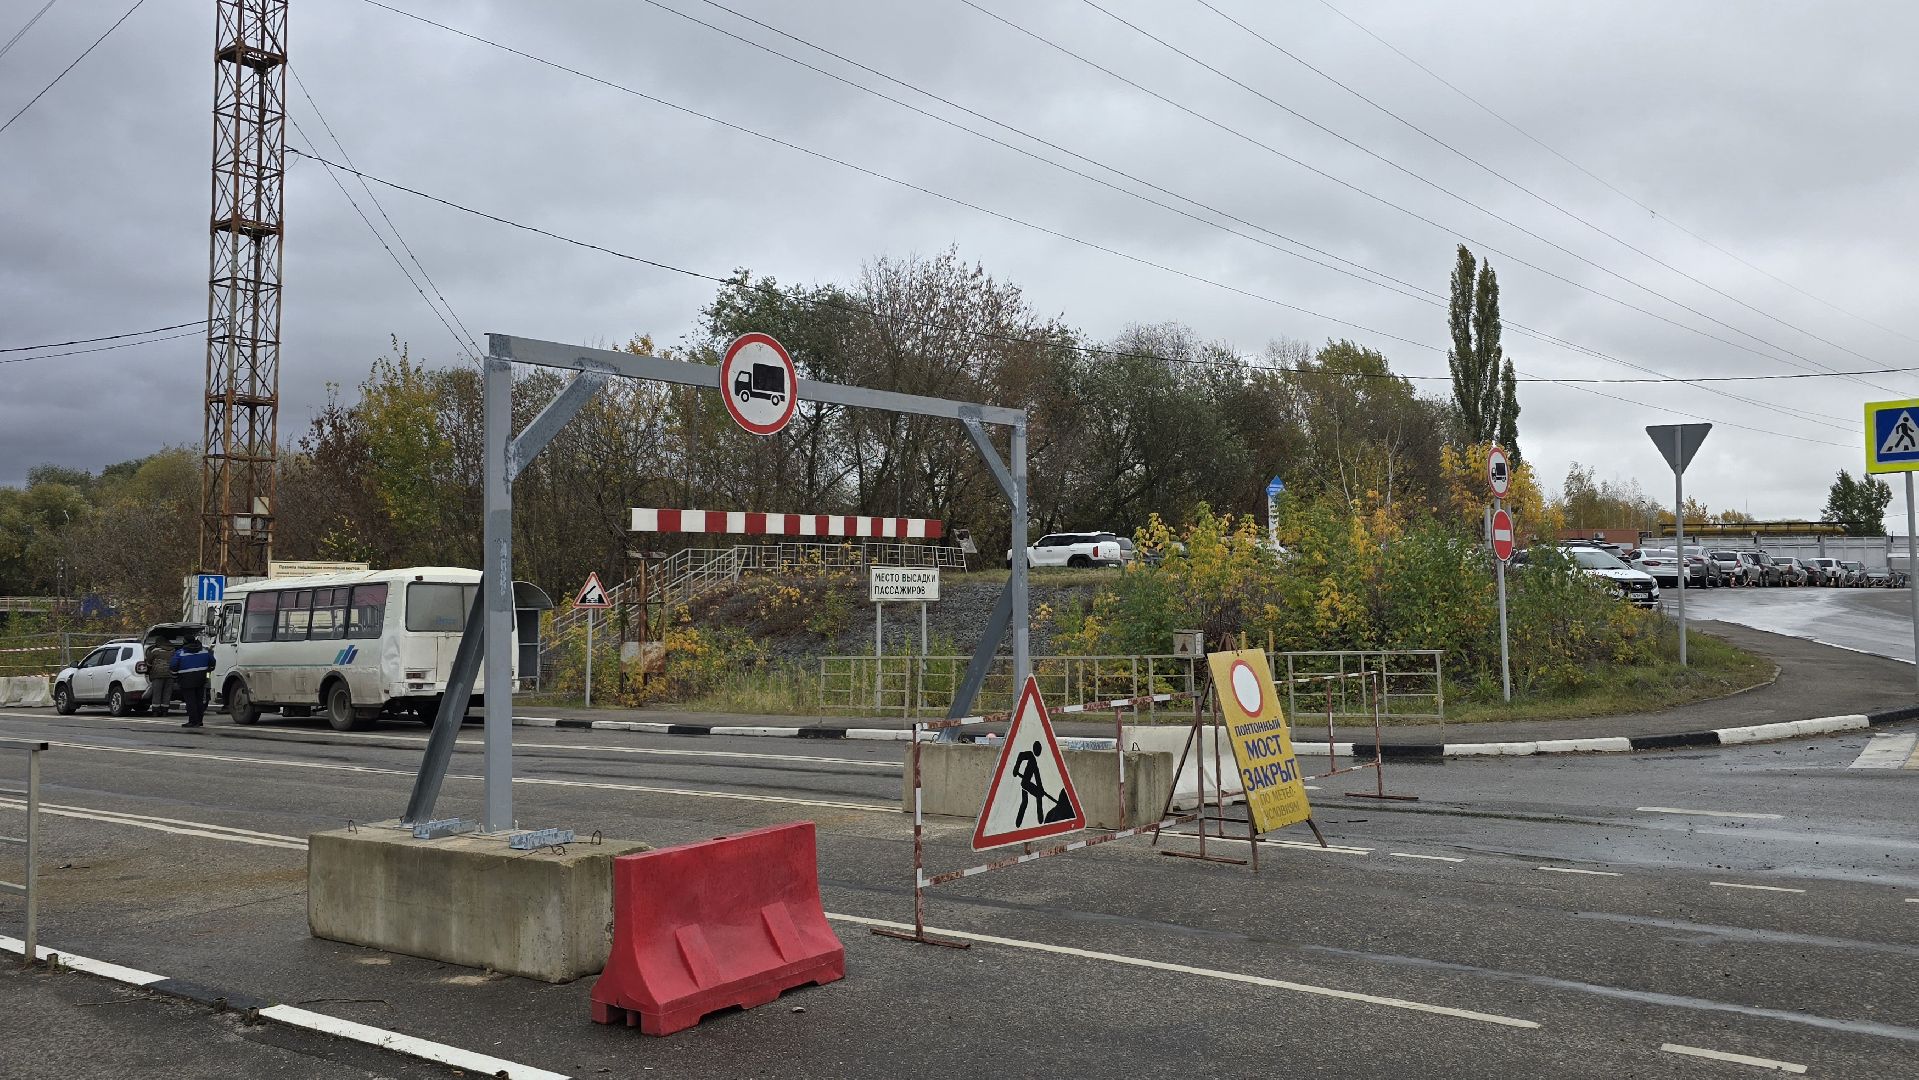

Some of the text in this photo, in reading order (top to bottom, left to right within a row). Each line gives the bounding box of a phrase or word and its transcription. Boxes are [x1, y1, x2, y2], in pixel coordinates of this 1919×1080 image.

[874, 573, 936, 584] МЕСТО ВЫСАДКИ
[874, 585, 926, 595] ПАССАЖИРОВ
[1234, 718, 1281, 737] ПОНТОННЫЙ
[1244, 734, 1283, 760] МОСТ
[1242, 758, 1298, 792] ЗАКРЫТ
